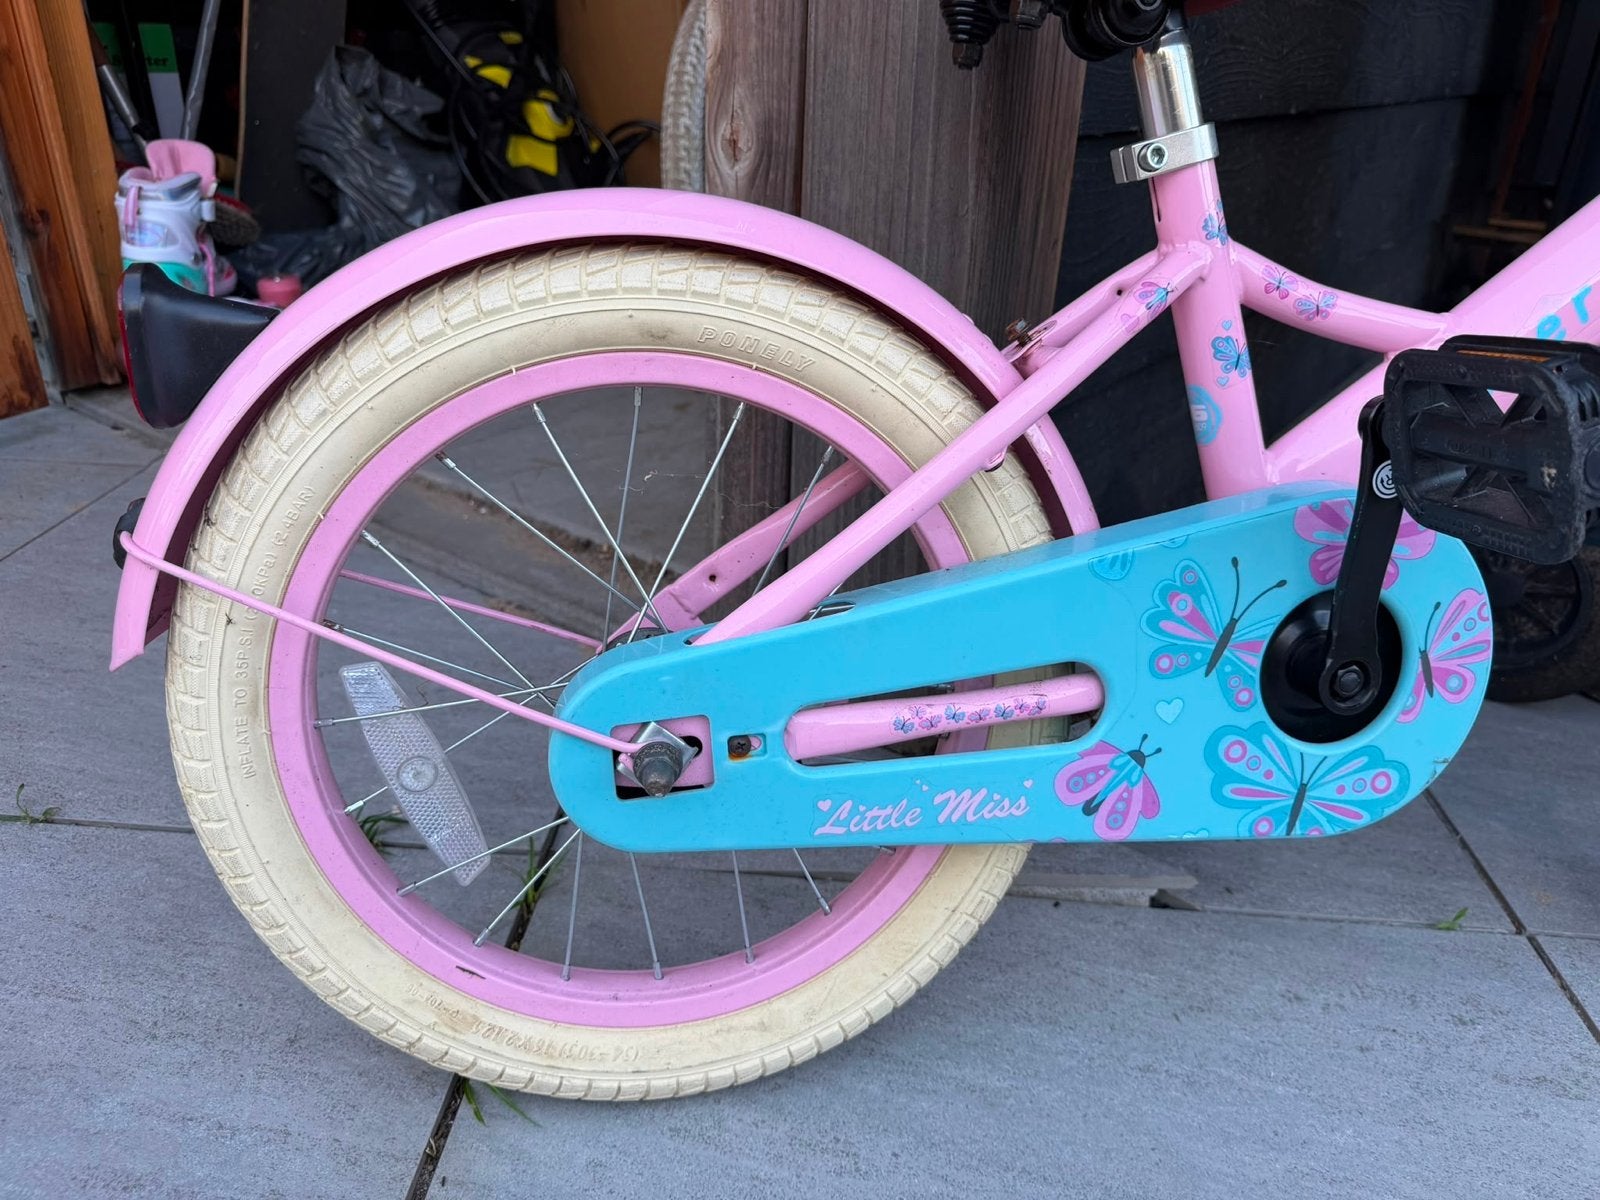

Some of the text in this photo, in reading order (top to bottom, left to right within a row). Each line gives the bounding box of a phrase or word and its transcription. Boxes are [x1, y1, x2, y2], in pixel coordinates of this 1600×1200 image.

[698, 325, 816, 373] PONELY
[245, 552, 278, 621] (20KPa)
[233, 687, 249, 709] TO
[235, 716, 257, 779] INFLATE
[814, 787, 1030, 836] Little Miss
